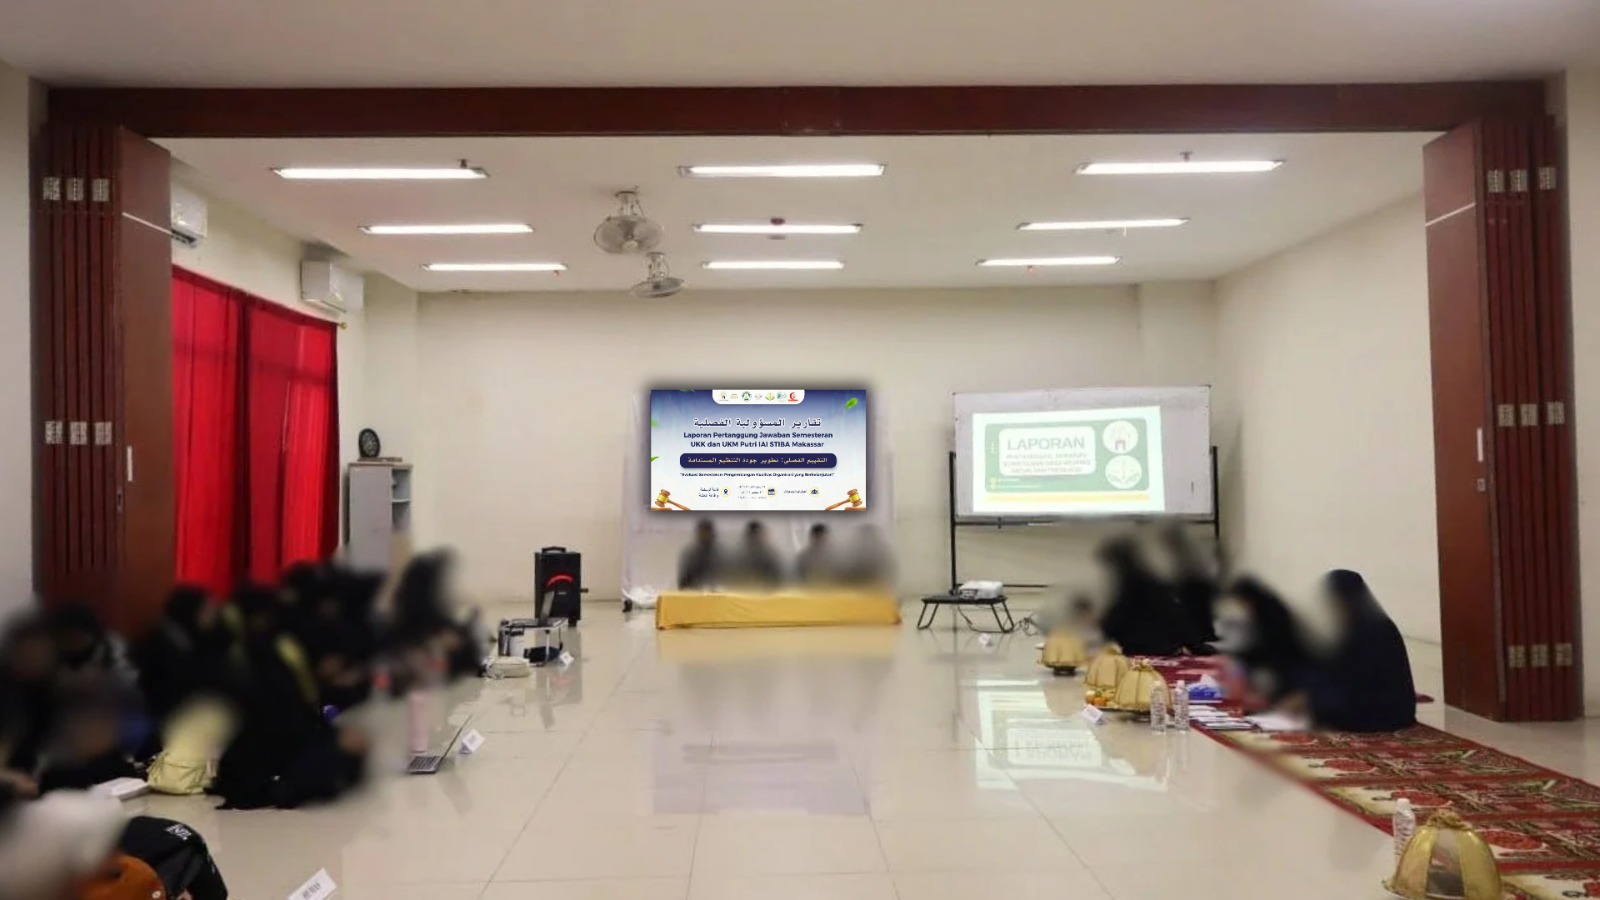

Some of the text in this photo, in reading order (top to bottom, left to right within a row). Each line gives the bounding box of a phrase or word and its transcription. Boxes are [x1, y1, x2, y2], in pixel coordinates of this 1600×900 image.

[683, 431, 834, 440] Laporan Pertanggung Jawaban Semesteran
[1007, 436, 1085, 451] LAPORAN
